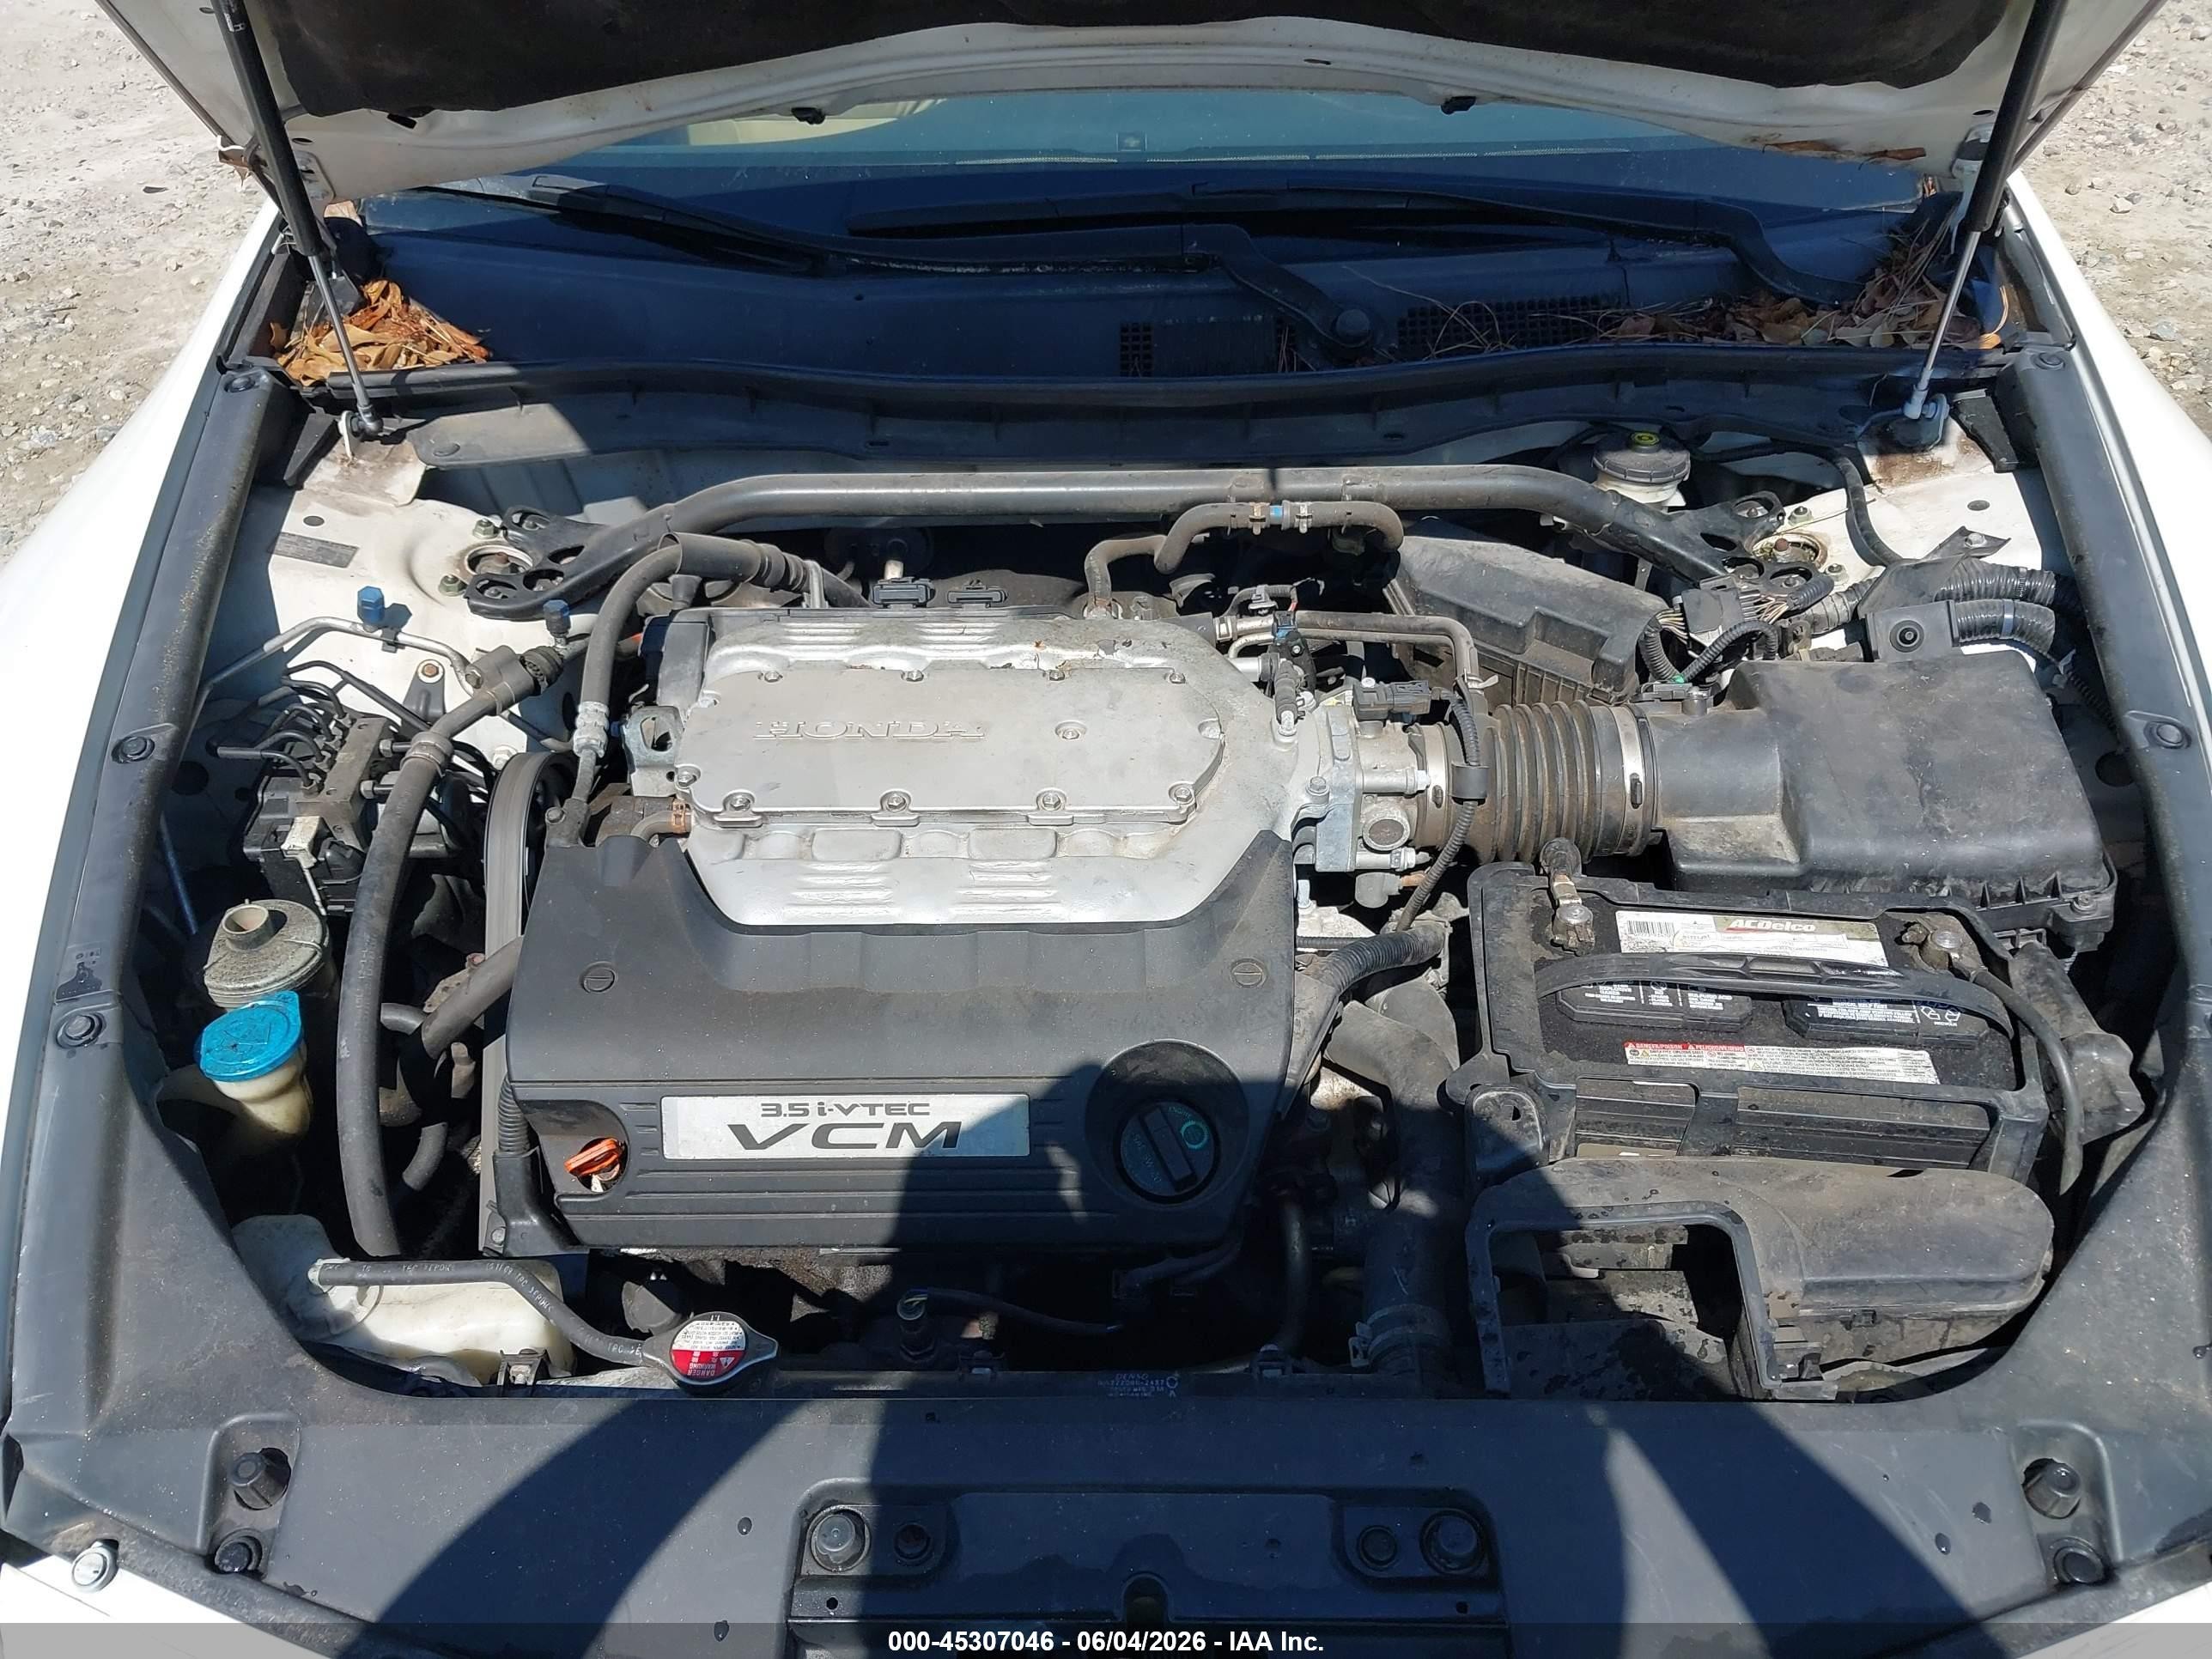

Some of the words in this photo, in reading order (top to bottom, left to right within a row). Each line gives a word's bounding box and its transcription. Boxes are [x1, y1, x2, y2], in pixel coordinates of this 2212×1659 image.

[753, 720, 986, 739] HONDA
[1729, 918, 1816, 933] ACDelco
[761, 1103, 810, 1117] 3.5
[817, 1102, 931, 1116] i-VTEC
[726, 1121, 963, 1151] VCM
